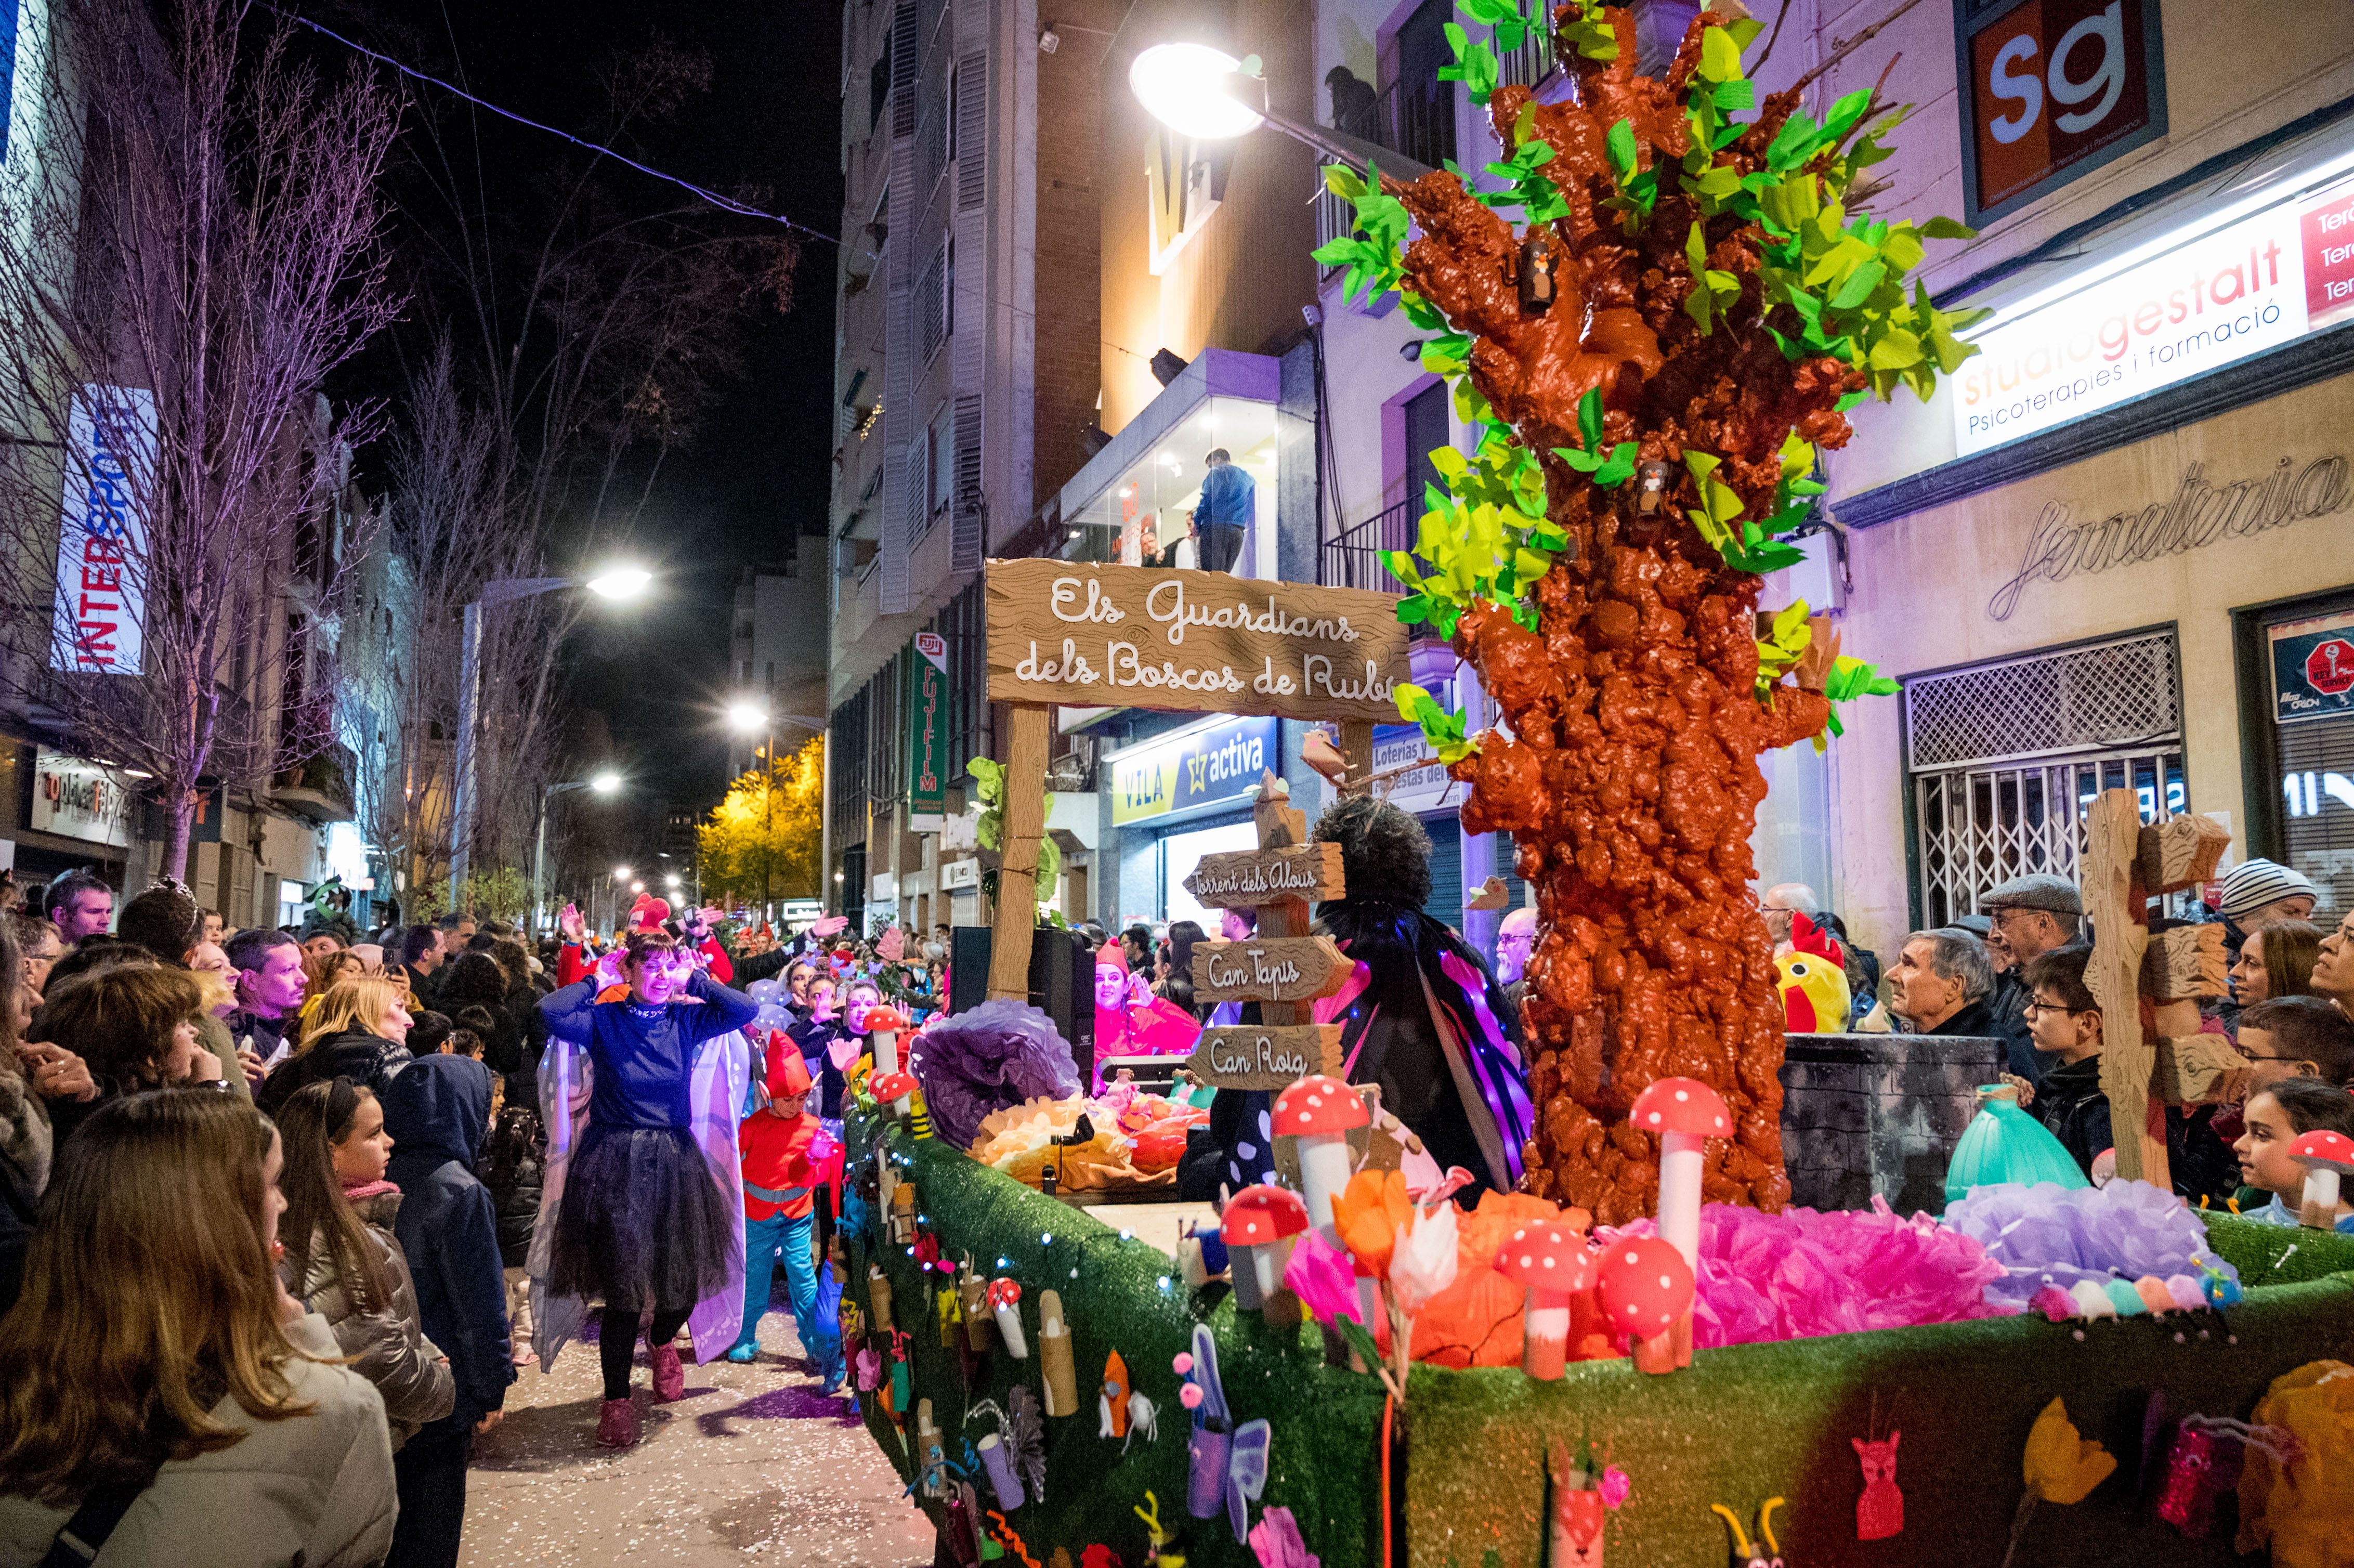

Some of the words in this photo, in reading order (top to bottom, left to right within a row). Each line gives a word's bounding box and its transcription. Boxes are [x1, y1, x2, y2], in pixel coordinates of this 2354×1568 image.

[1990, 1, 2125, 144] sg
[1965, 239, 2281, 406] studiogestalt
[1969, 365, 2122, 435] Psicoterapies
[2134, 354, 2137, 373] i
[2149, 298, 2280, 367] formació
[1051, 577, 1124, 623] Els
[1146, 580, 1359, 646] Guardians
[1015, 638, 1100, 684] dels
[1108, 641, 1245, 693] Boscos
[1253, 657, 1296, 695] de
[920, 666, 937, 791] FUJIFILM
[1375, 740, 1417, 766] Loterías
[1421, 741, 1427, 759] y
[1126, 764, 1163, 808] VILA
[1210, 732, 1263, 782] activa
[1193, 870, 1238, 896] Torrent
[1241, 872, 1267, 892] dels
[1268, 861, 1317, 890] Alous
[1209, 954, 1248, 988] Can
[1248, 950, 1300, 1000] Tapis
[1211, 1038, 1251, 1074] Can
[1257, 1036, 1307, 1079] Roig
